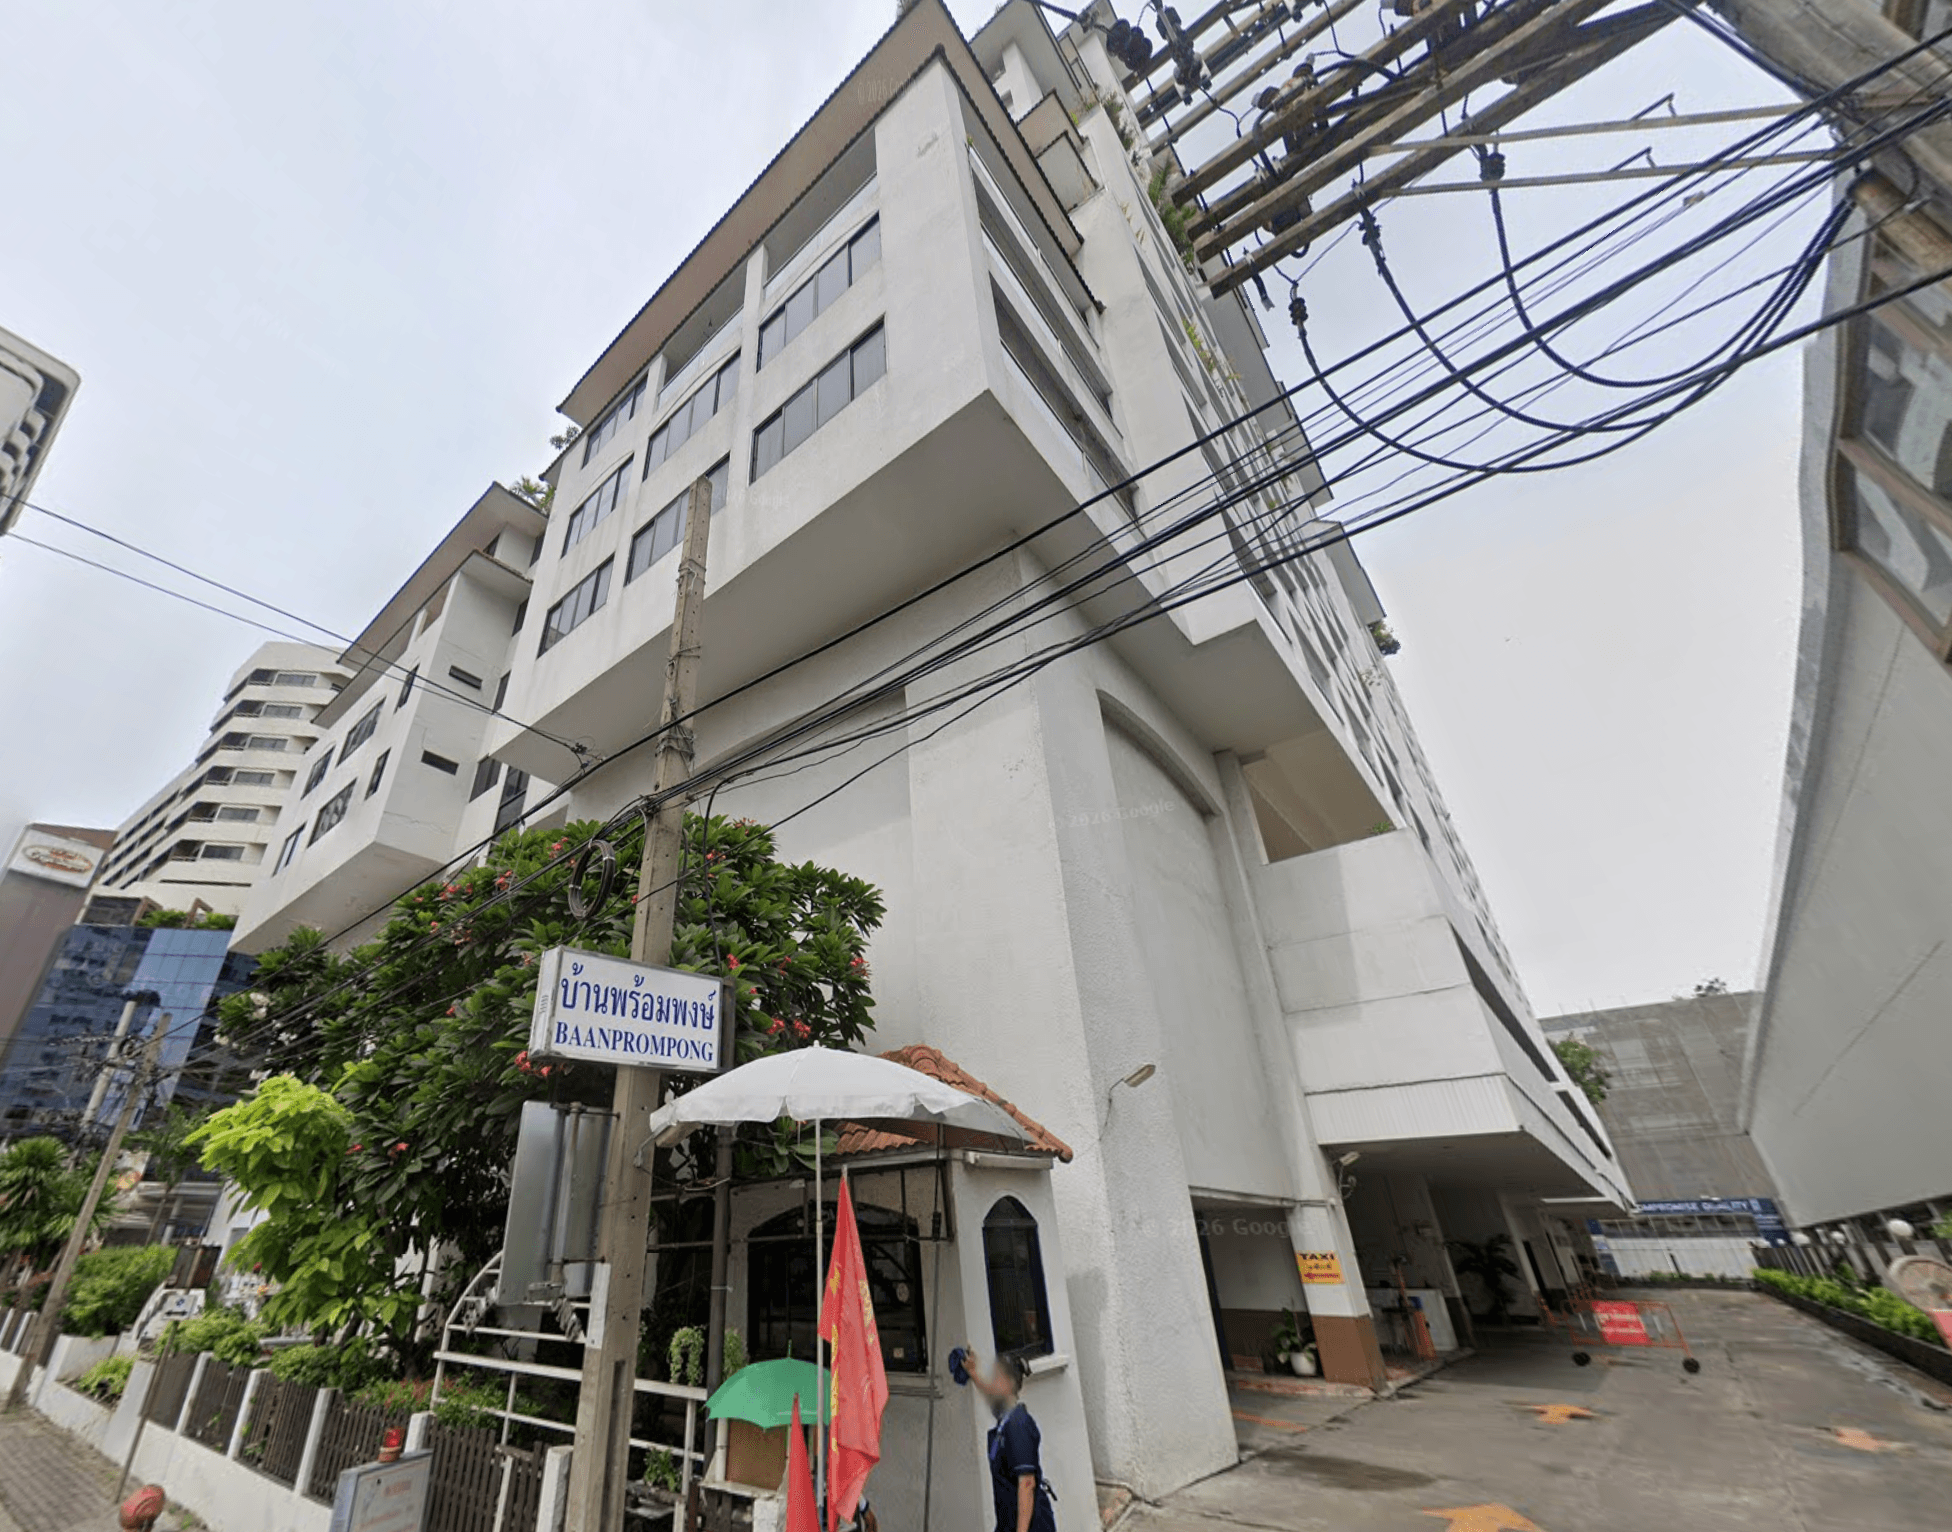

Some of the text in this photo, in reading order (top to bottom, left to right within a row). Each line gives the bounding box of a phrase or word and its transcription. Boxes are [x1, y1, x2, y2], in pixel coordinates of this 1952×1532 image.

[561, 962, 717, 1030] บ้านพร้อมพงษ์
[554, 1021, 714, 1062] BAANPROMPONG
[1636, 1202, 1700, 1211] OMPROMISE
[1299, 1253, 1335, 1261] TAXI
